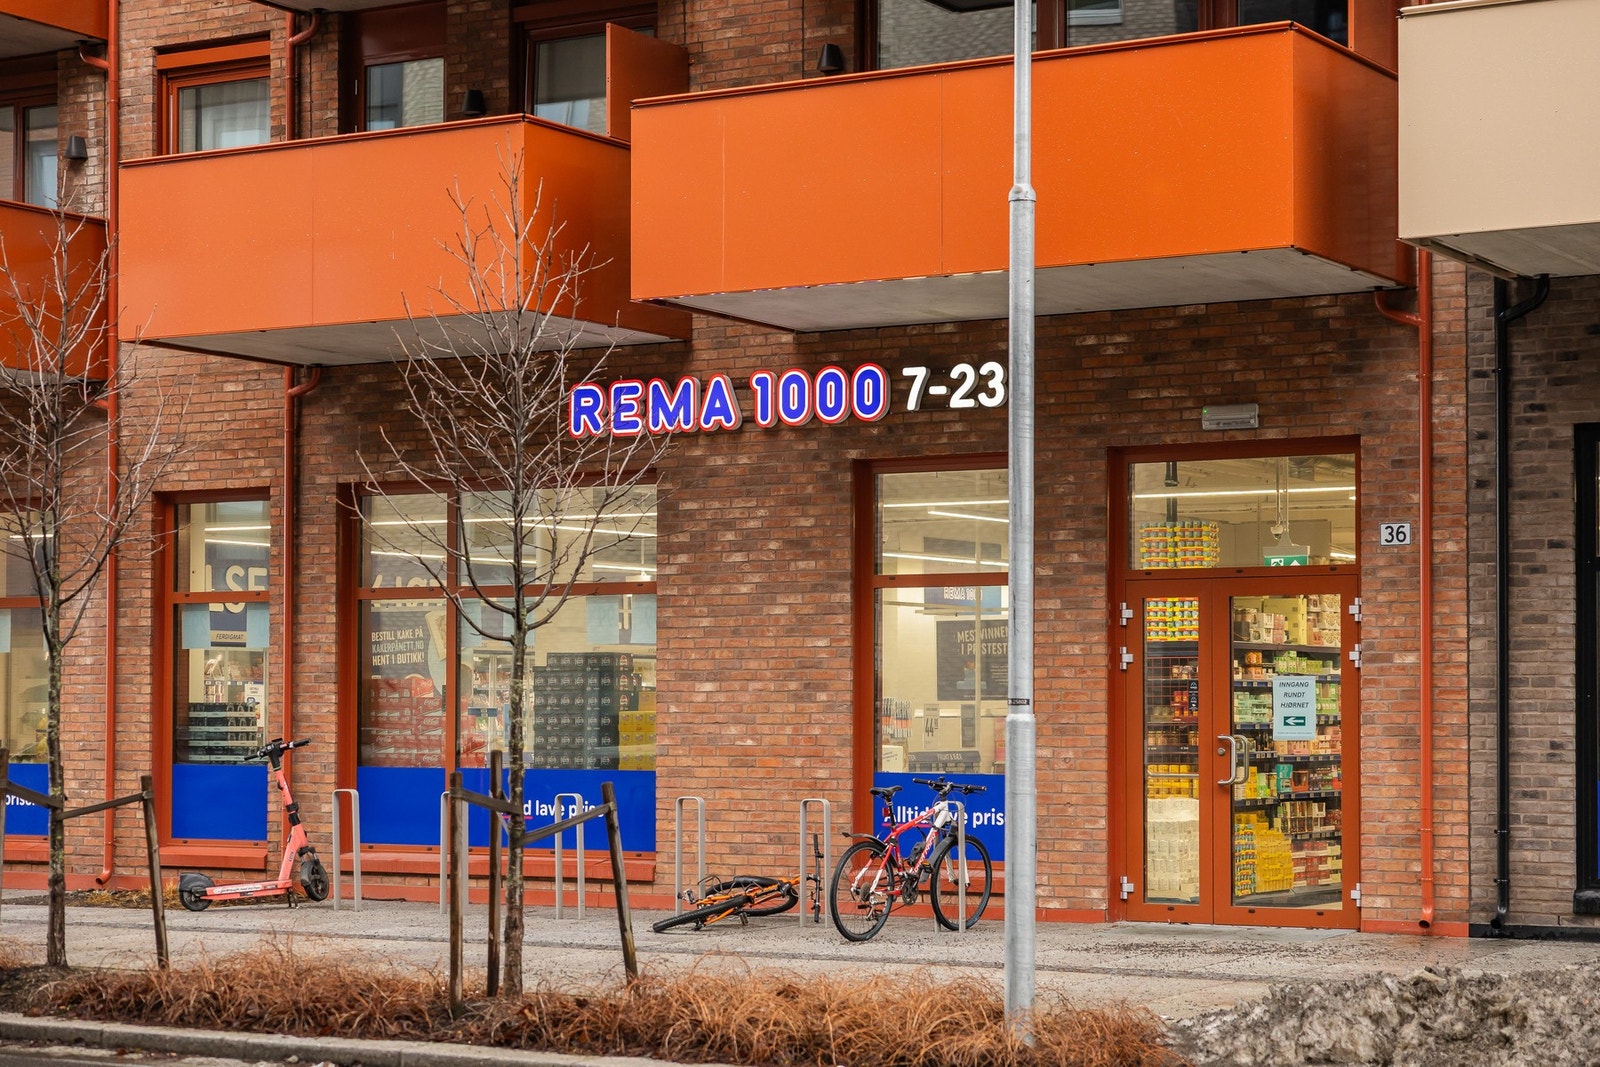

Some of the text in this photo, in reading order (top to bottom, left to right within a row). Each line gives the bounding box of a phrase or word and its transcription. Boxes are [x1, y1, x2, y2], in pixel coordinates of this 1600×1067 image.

[569, 361, 1006, 438] REMA 1000 7-23
[1385, 525, 1407, 544] 36
[371, 626, 423, 642] BESTILL KAKE PÅ
[372, 655, 389, 666] HENT
[397, 652, 425, 665] BUTIKK!
[972, 808, 1005, 828] pris
